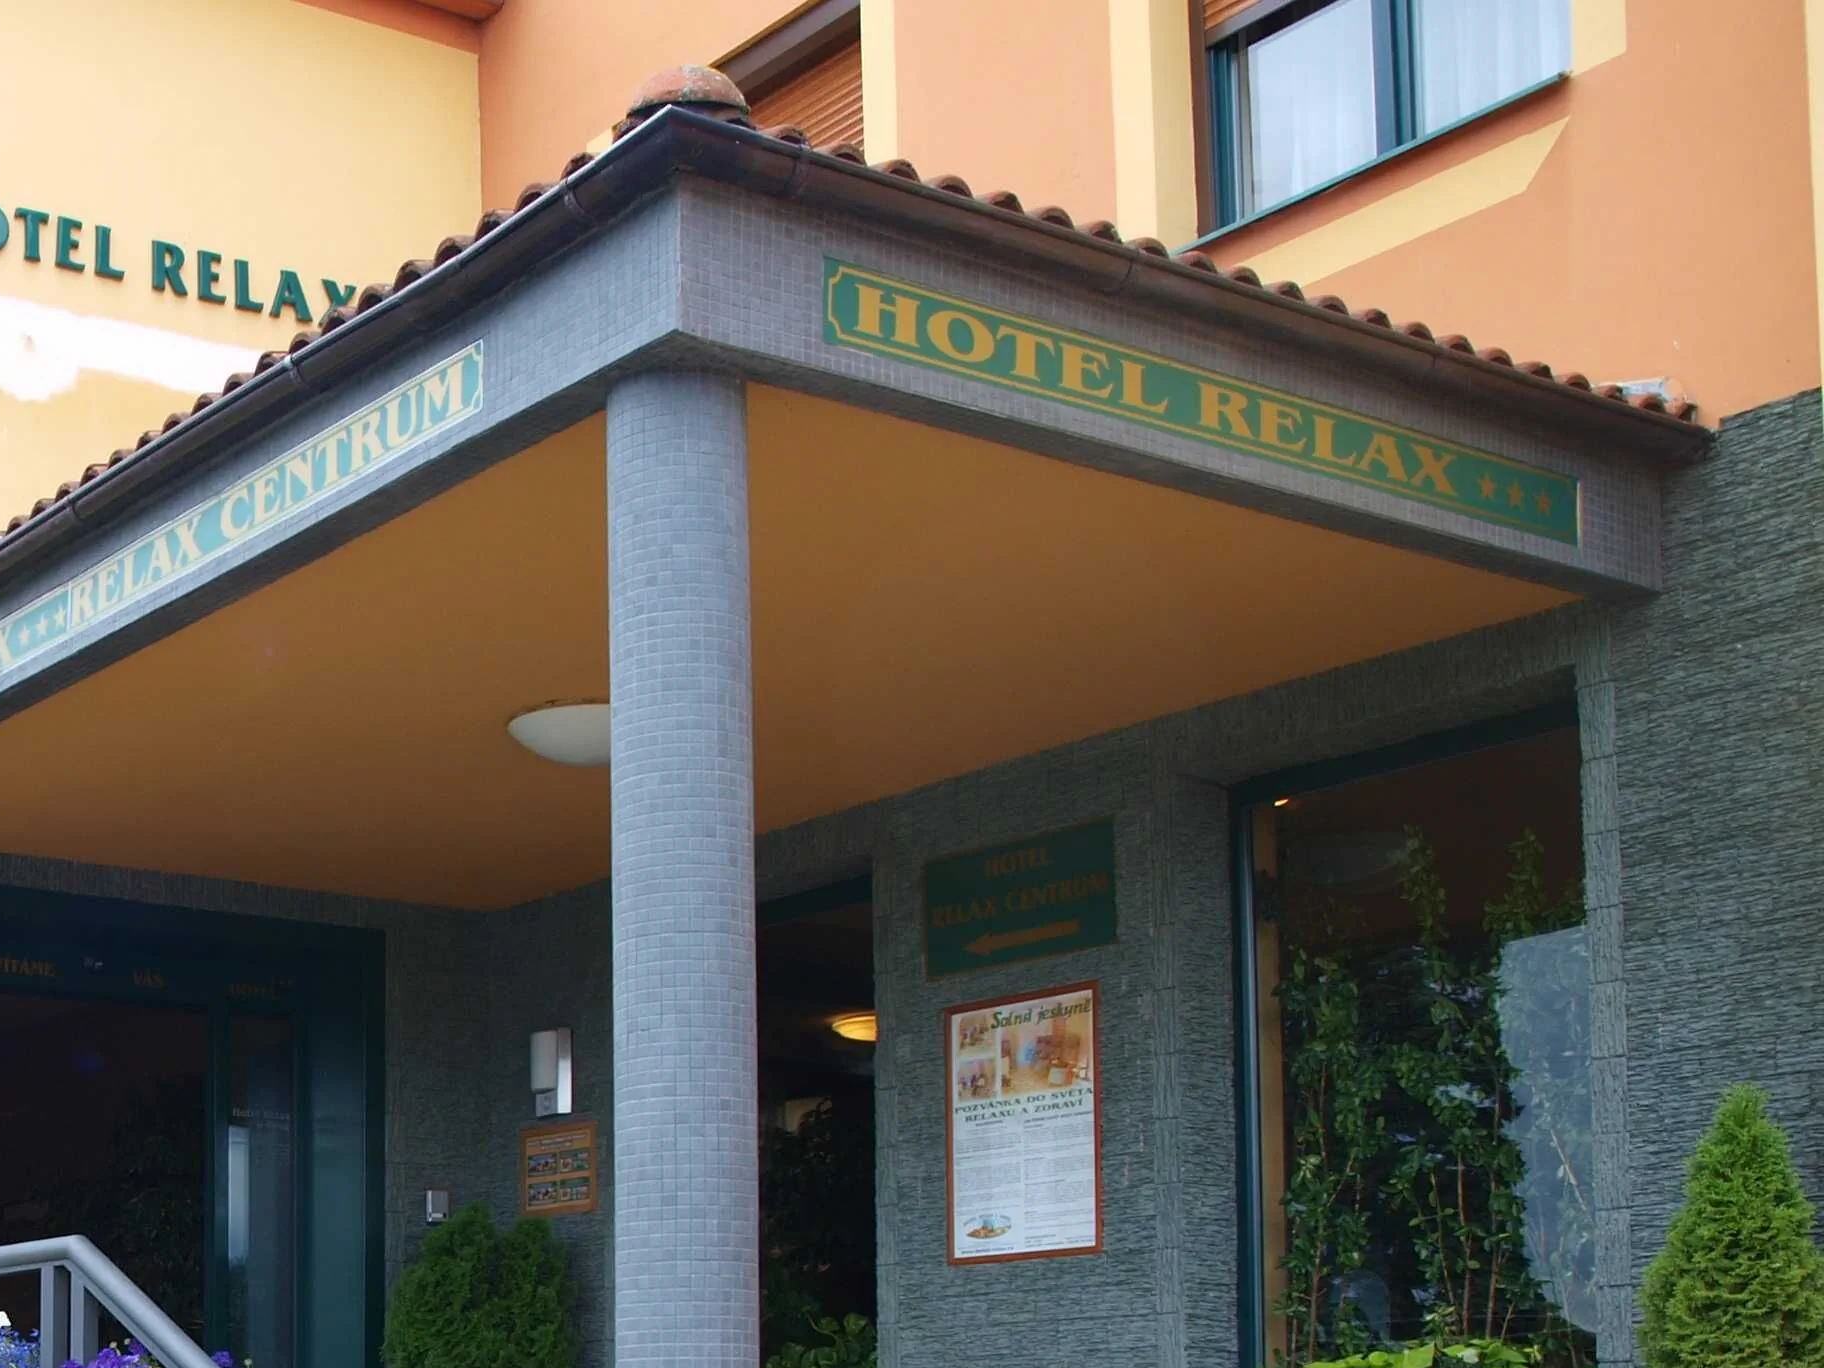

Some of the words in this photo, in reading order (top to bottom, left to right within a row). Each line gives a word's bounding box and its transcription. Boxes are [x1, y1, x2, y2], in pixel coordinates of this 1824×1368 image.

[150, 239, 356, 326] RELAX
[852, 281, 1170, 415] HOTEL
[1198, 380, 1460, 497] RELAX
[70, 516, 204, 630] RELAX
[219, 361, 466, 542] CENTRUM
[964, 1110, 1016, 1123] RELAXU
[1020, 1106, 1029, 1114] A
[1026, 1095, 1047, 1104] DO
